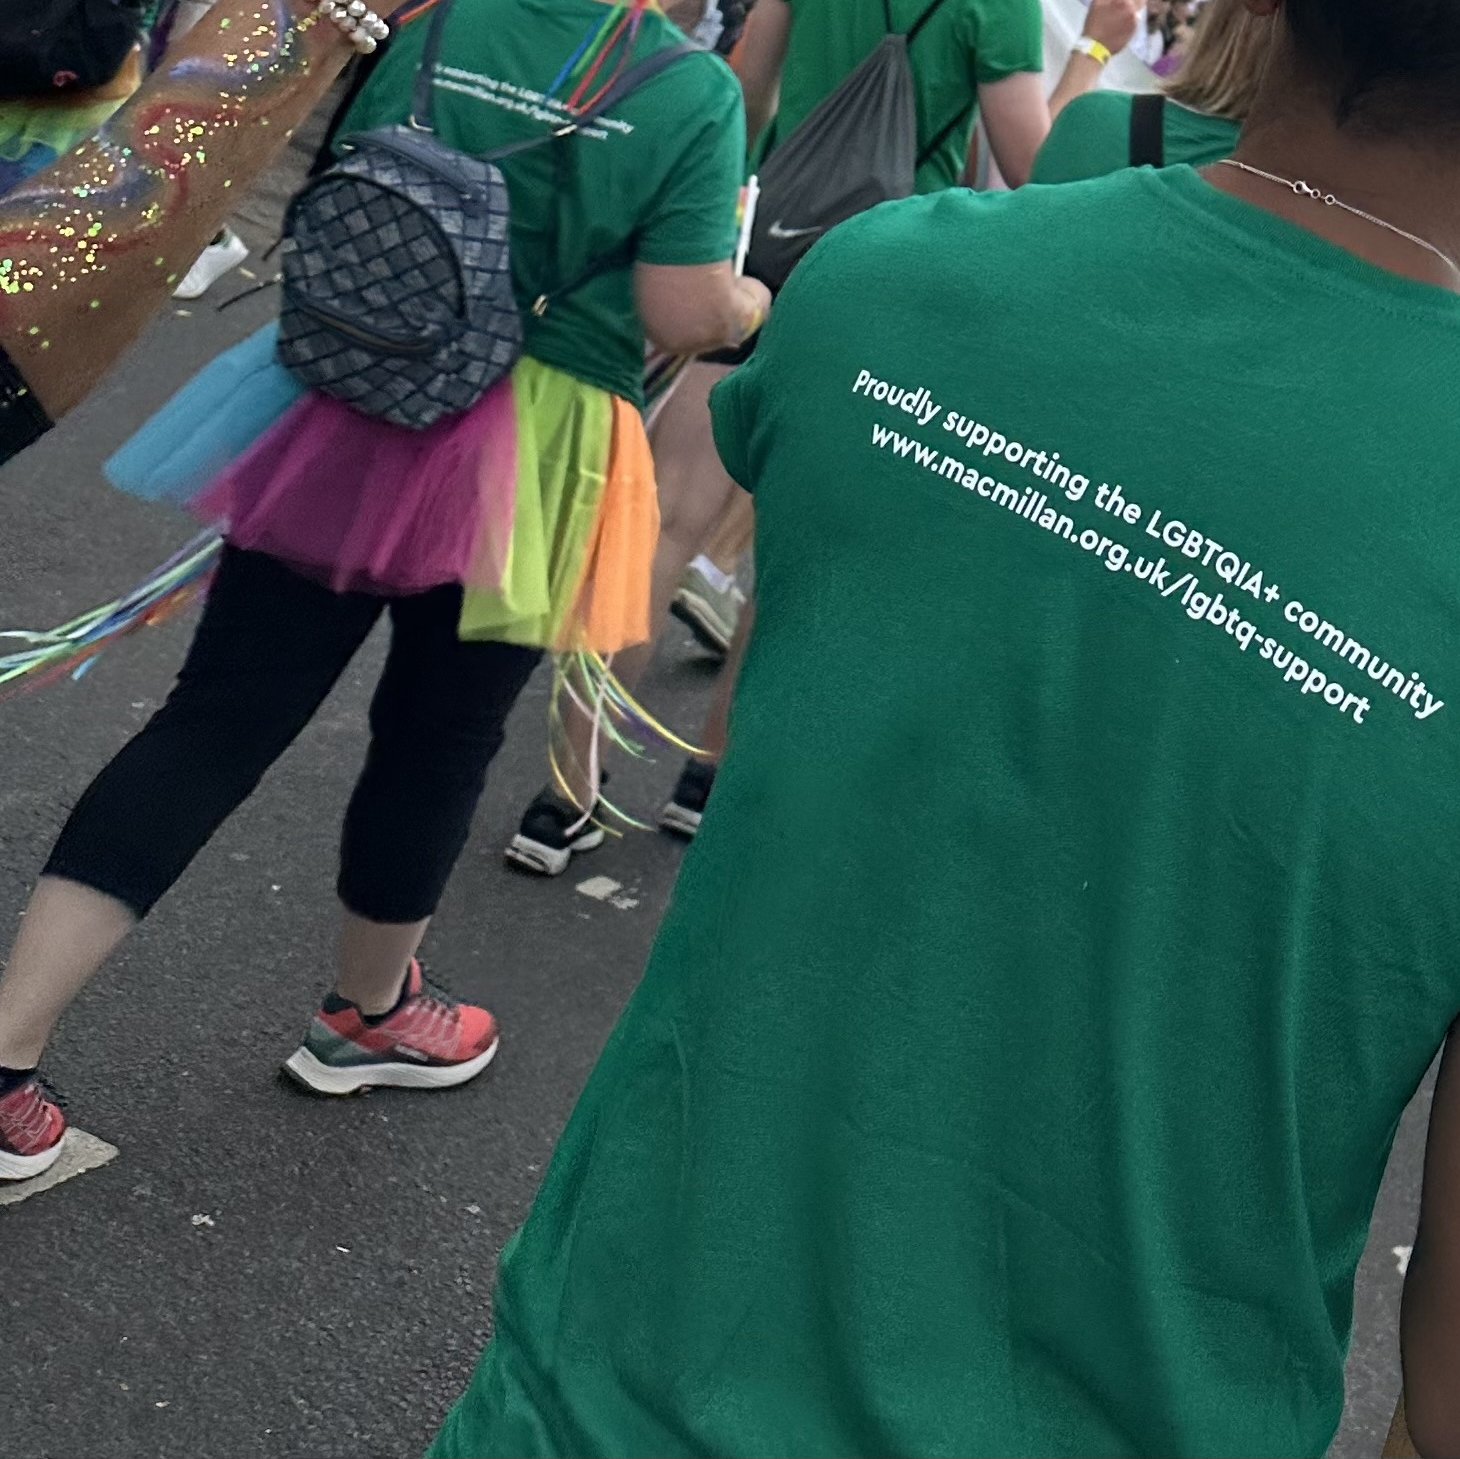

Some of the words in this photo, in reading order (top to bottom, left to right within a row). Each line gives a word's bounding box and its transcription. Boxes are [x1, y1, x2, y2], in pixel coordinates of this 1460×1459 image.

[852, 368, 942, 425] Proudly
[941, 407, 1091, 501] supporting
[1094, 480, 1144, 526] the
[1144, 508, 1282, 606] LGBTQIA+
[1282, 595, 1446, 721] community
[870, 423, 1372, 725] www.macmillan.org.uk/lgbtq-support
